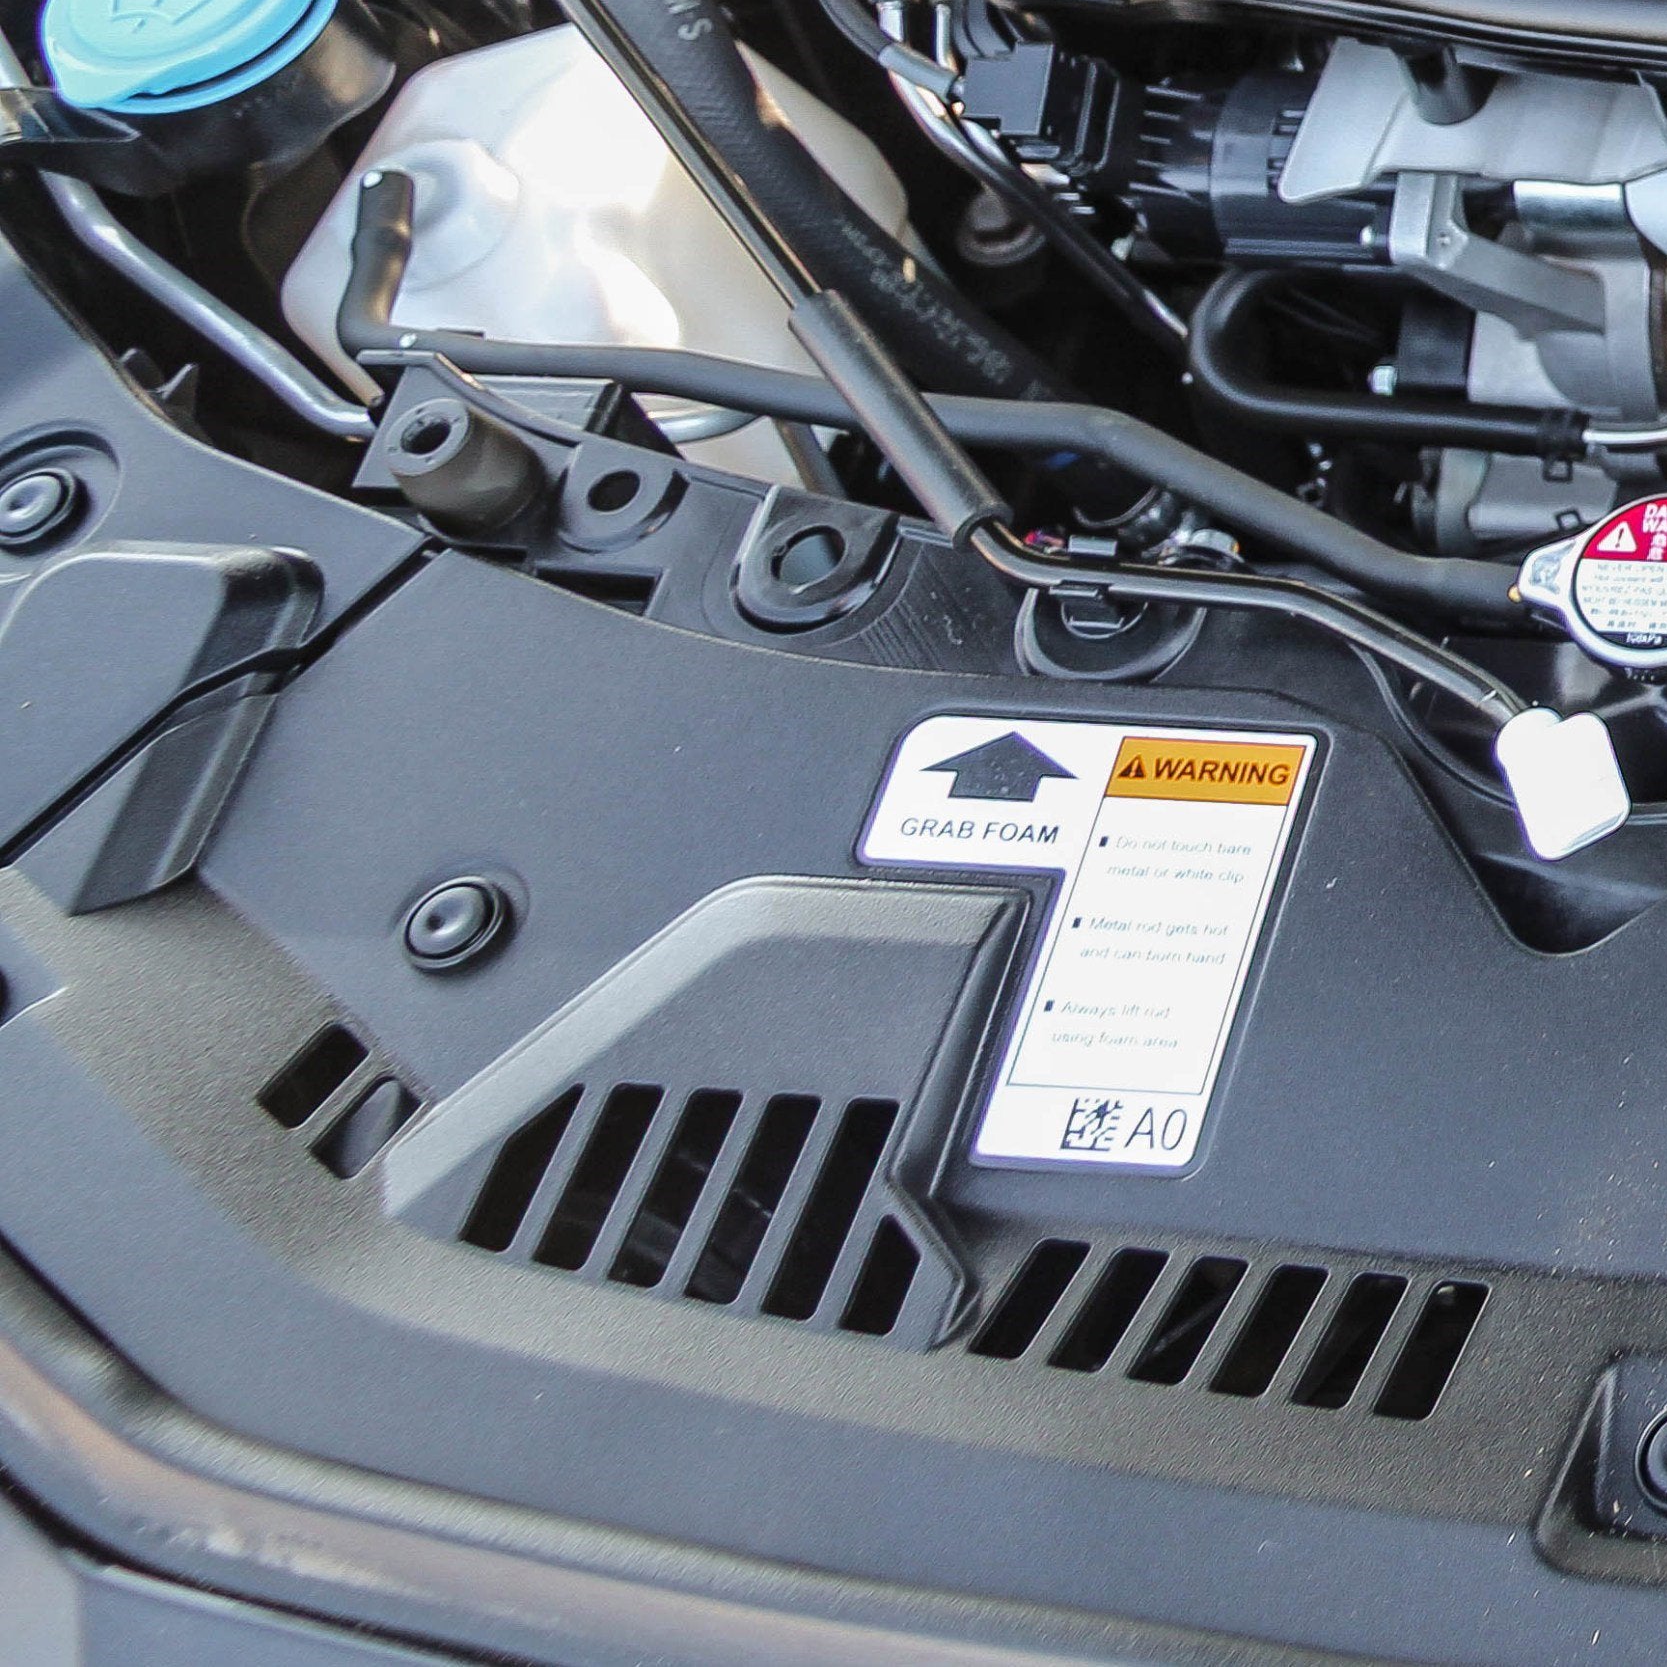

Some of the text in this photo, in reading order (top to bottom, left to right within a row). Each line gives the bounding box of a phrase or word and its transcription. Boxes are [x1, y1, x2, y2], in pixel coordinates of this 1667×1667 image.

[1153, 758, 1291, 785] WARNING
[900, 817, 1059, 844] GRAB FOAM
[1116, 836, 1137, 849] Do
[1142, 839, 1167, 851] not
[1171, 840, 1212, 853] touch
[1106, 866, 1245, 884] metal or white clip
[1089, 916, 1228, 937] Metal rod gets hot
[1080, 947, 1226, 964] and can burn hand
[1061, 1000, 1117, 1019] Always
[1121, 1004, 1140, 1017] lift
[1051, 1032, 1095, 1047] using
